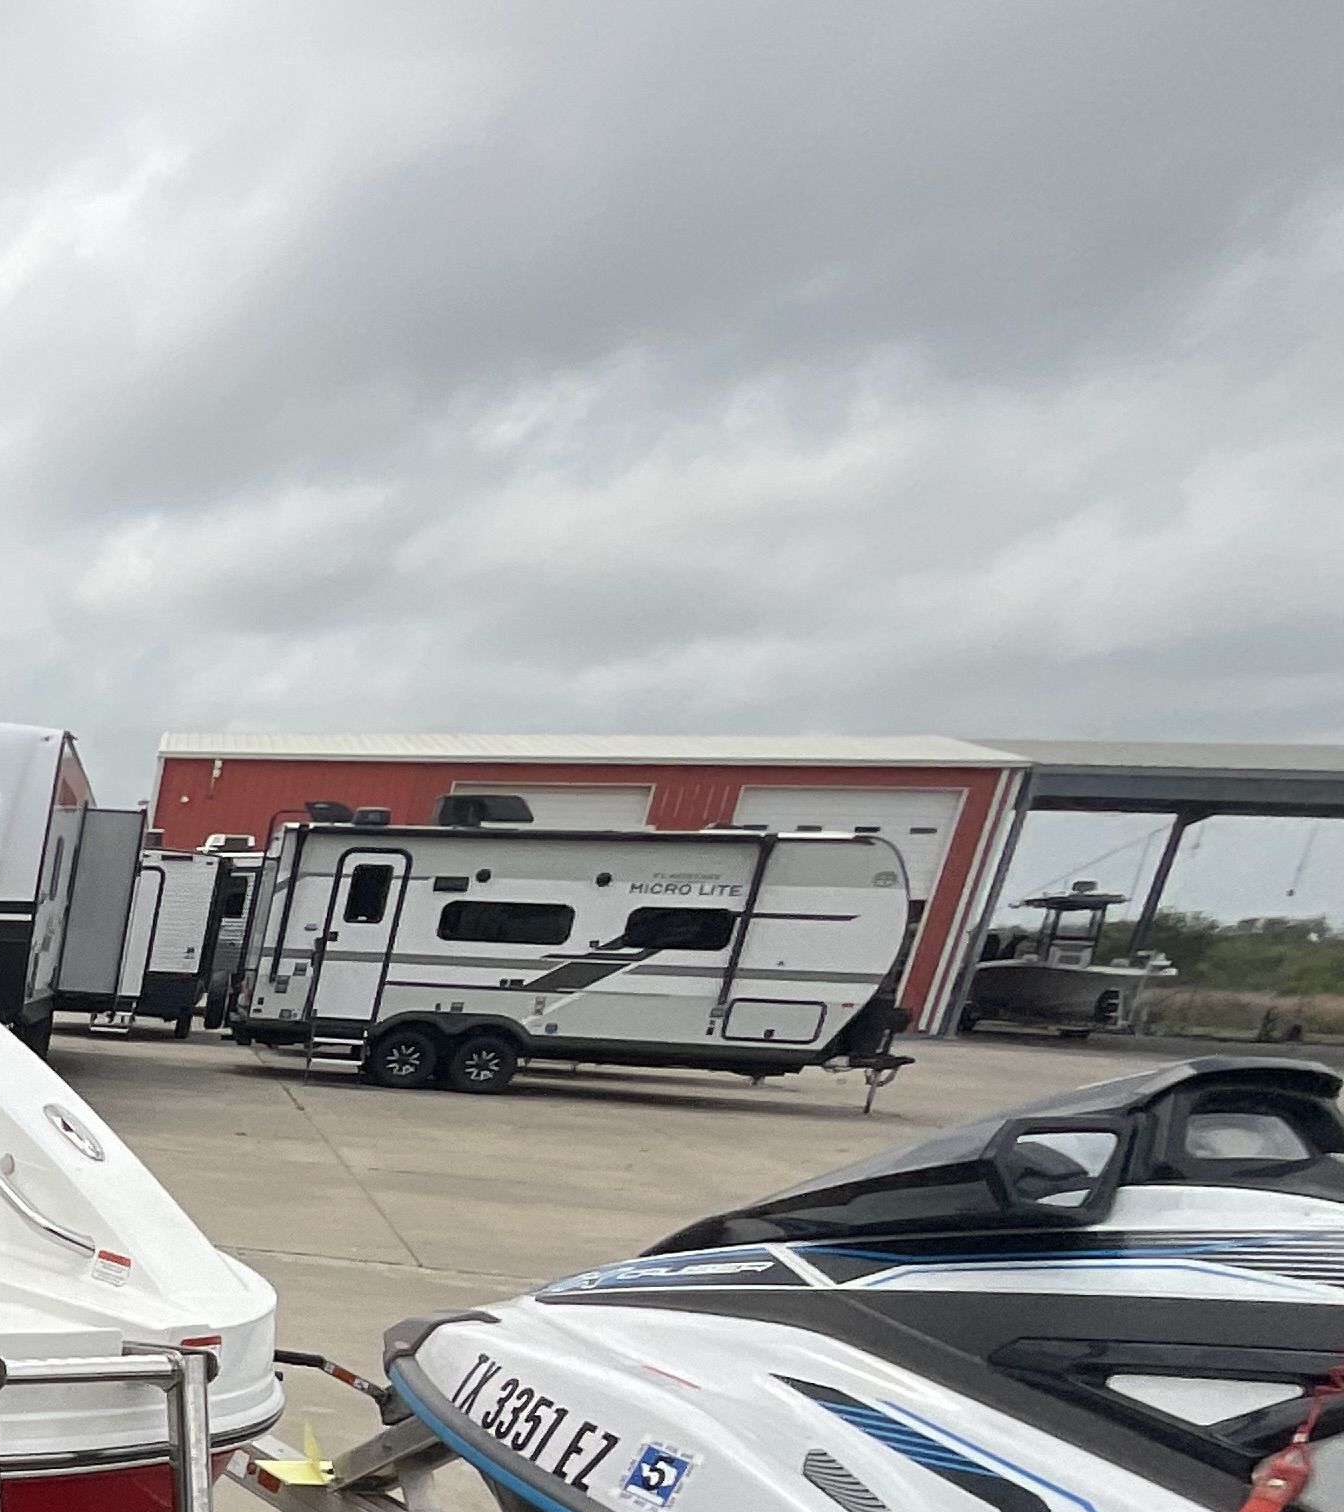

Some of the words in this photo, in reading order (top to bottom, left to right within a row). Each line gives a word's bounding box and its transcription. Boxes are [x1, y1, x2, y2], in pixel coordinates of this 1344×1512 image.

[628, 882, 692, 896] MICRO
[698, 884, 744, 897] LITE
[451, 1353, 503, 1416] TX
[481, 1378, 569, 1463] 3351
[552, 1420, 622, 1493] EZ
[640, 1455, 675, 1492] 5
